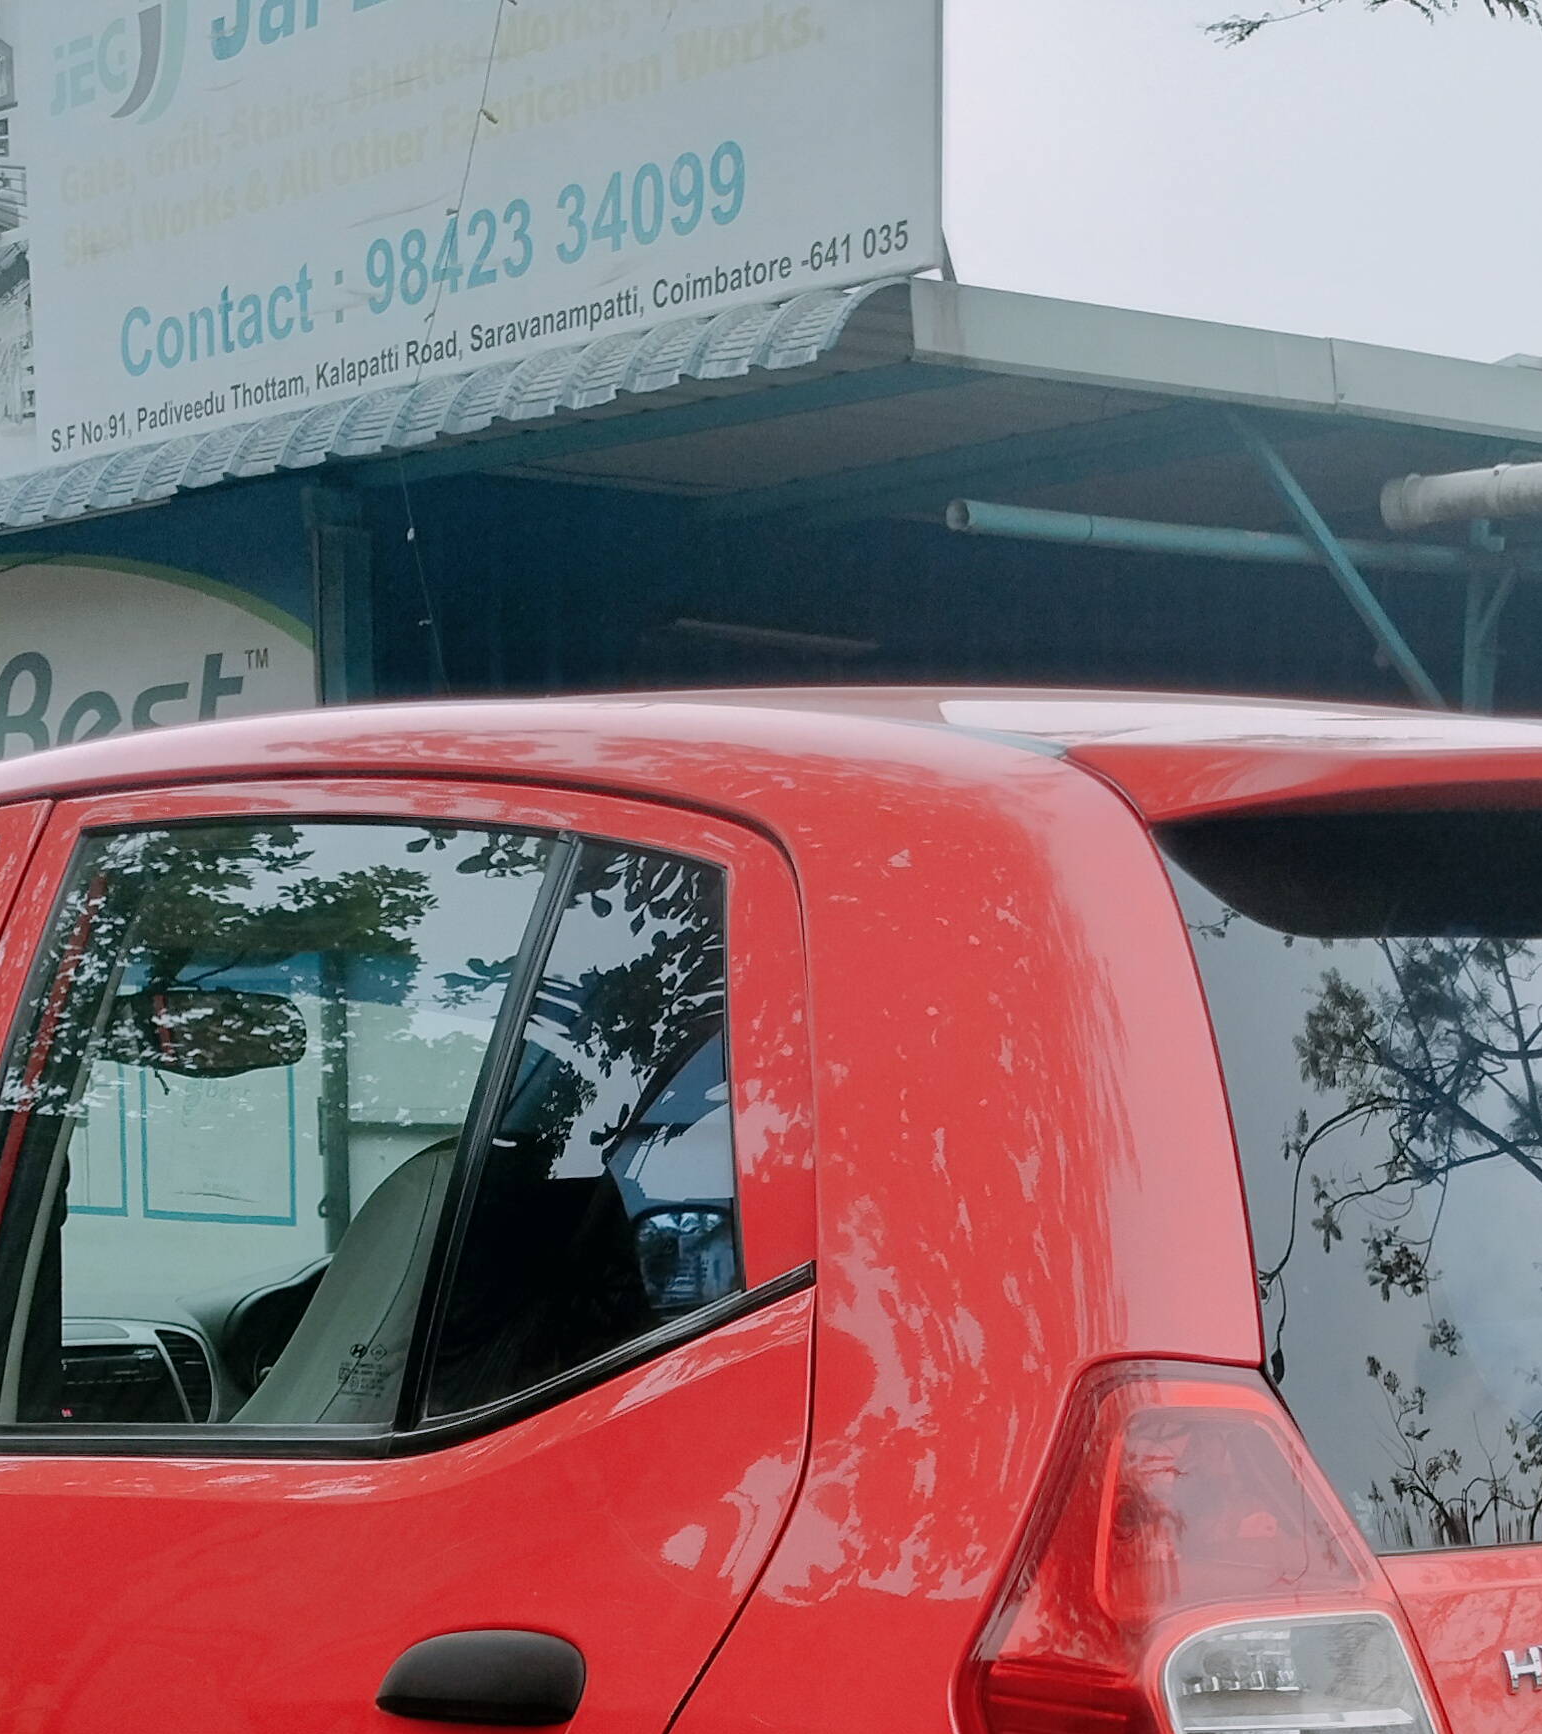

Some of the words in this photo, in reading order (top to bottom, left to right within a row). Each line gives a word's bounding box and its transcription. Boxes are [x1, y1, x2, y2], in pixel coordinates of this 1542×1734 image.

[120, 262, 314, 377] Contact
[366, 198, 534, 315] 98423
[556, 140, 745, 265] 34099
[137, 393, 225, 432] Padiveedu
[230, 372, 309, 409] Thottam,
[316, 342, 400, 389] Kalapatti
[406, 330, 463, 369] Road,
[469, 288, 645, 352] Saravanampatti,
[653, 251, 792, 308] Coimbatore
[863, 219, 908, 259] 035
